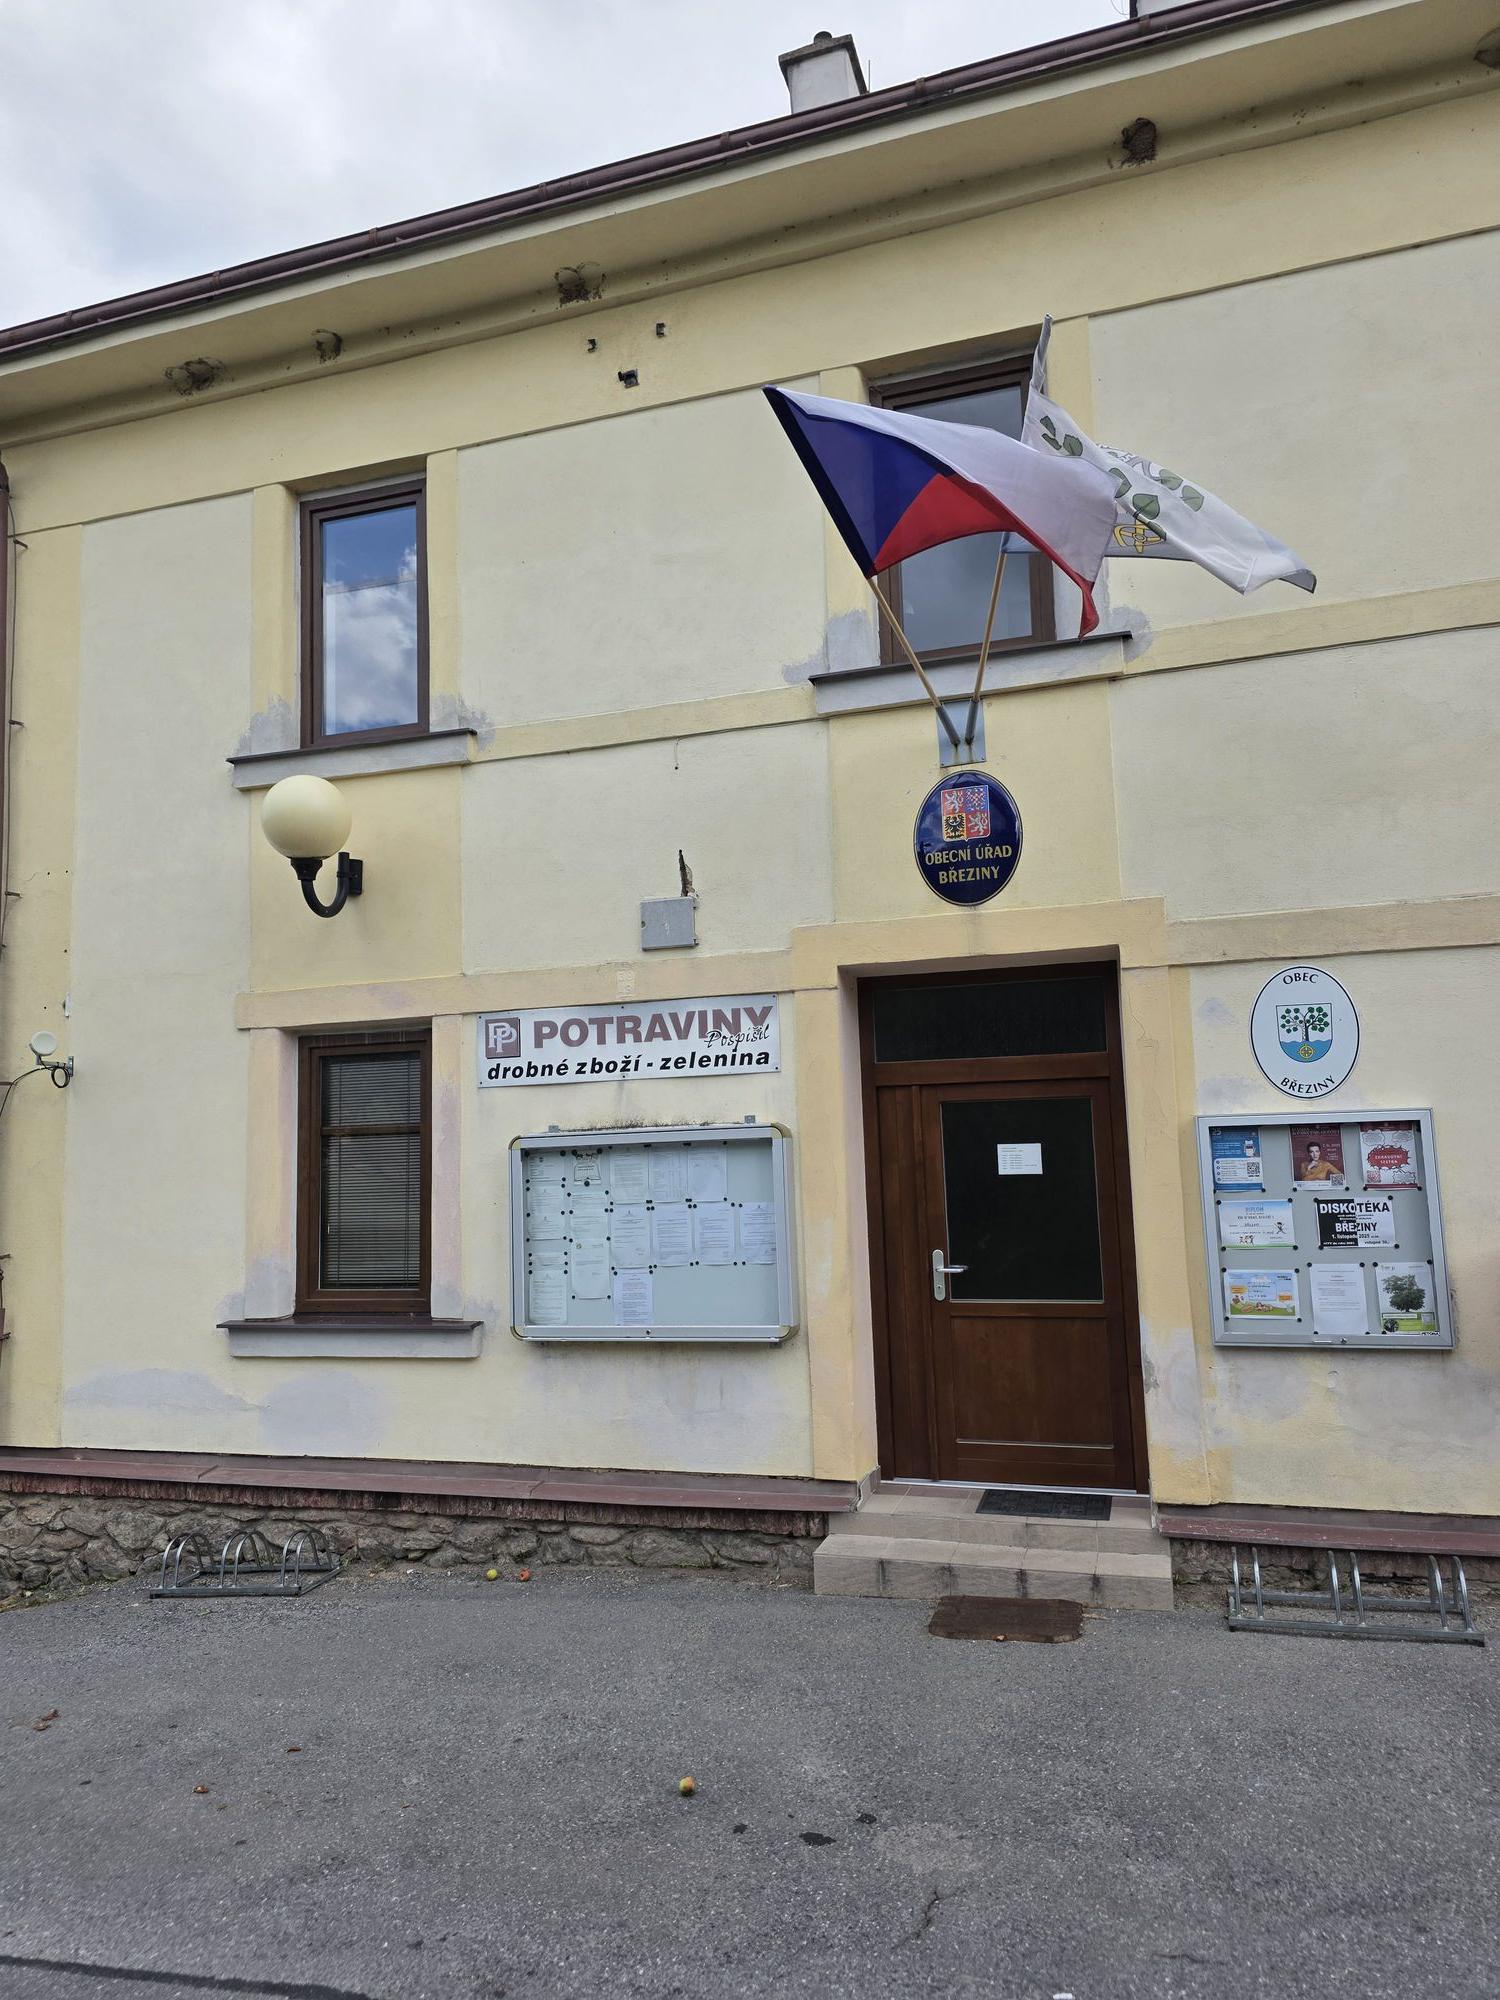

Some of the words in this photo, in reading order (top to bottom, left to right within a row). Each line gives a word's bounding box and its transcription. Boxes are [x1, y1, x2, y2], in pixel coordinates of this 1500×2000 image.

[925, 845, 971, 865] OBECNÍ
[976, 843, 1012, 860] ÚŘAD
[938, 866, 1000, 884] BŘEZINY
[1282, 972, 1319, 985] OBEC
[533, 1005, 773, 1049] POTRAVINY
[704, 1024, 770, 1051] Pospíšil
[487, 1059, 569, 1080] drobné
[575, 1054, 640, 1075] zboží
[659, 1050, 770, 1071] zelenina
[1280, 1075, 1336, 1094] BŘEZINY
[1319, 1200, 1390, 1214] DISKOTÉKA
[1335, 1221, 1378, 1233] BŘEZINY
